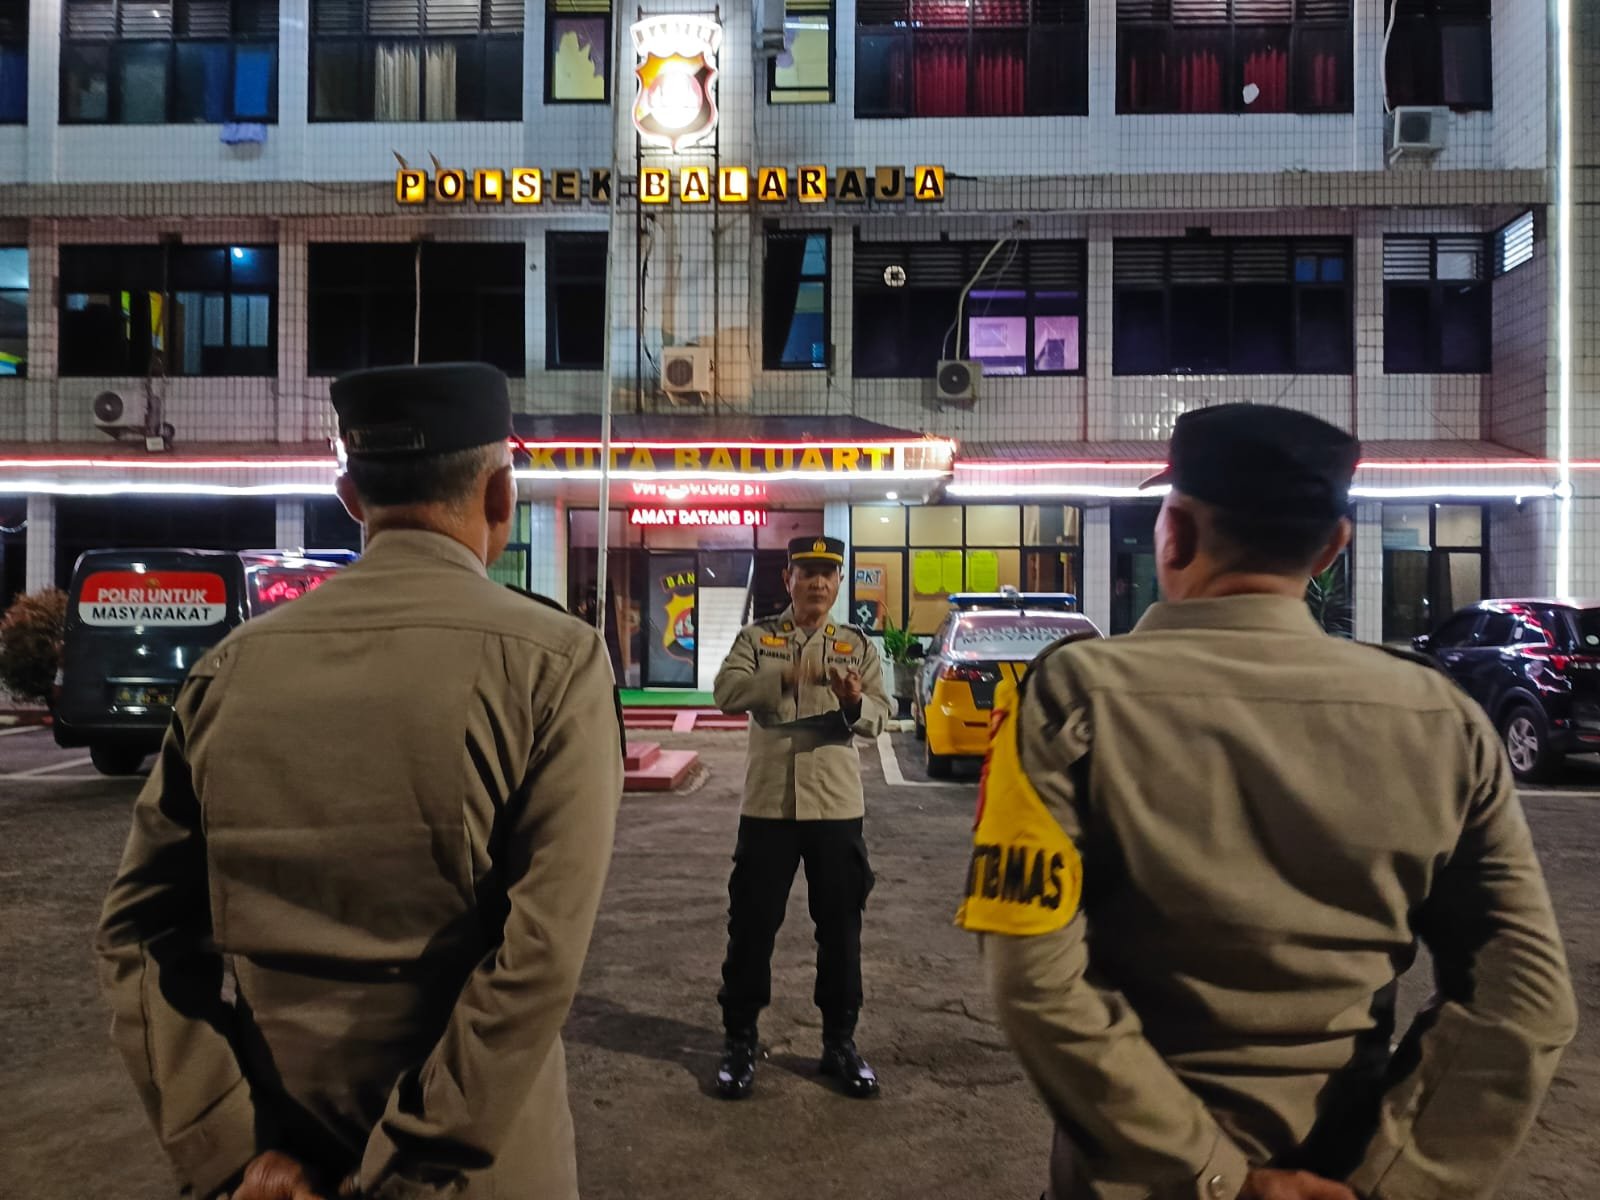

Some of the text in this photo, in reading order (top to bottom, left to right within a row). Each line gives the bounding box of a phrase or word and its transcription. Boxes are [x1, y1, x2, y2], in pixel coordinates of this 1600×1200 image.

[401, 170, 940, 199] POLSEK BALARAJA
[675, 446, 891, 472] BALUART
[631, 508, 677, 525] AMAT
[679, 508, 741, 525] DATANG
[97, 588, 208, 604] POLRI UNTUK
[91, 605, 212, 621] MASYARAKAT
